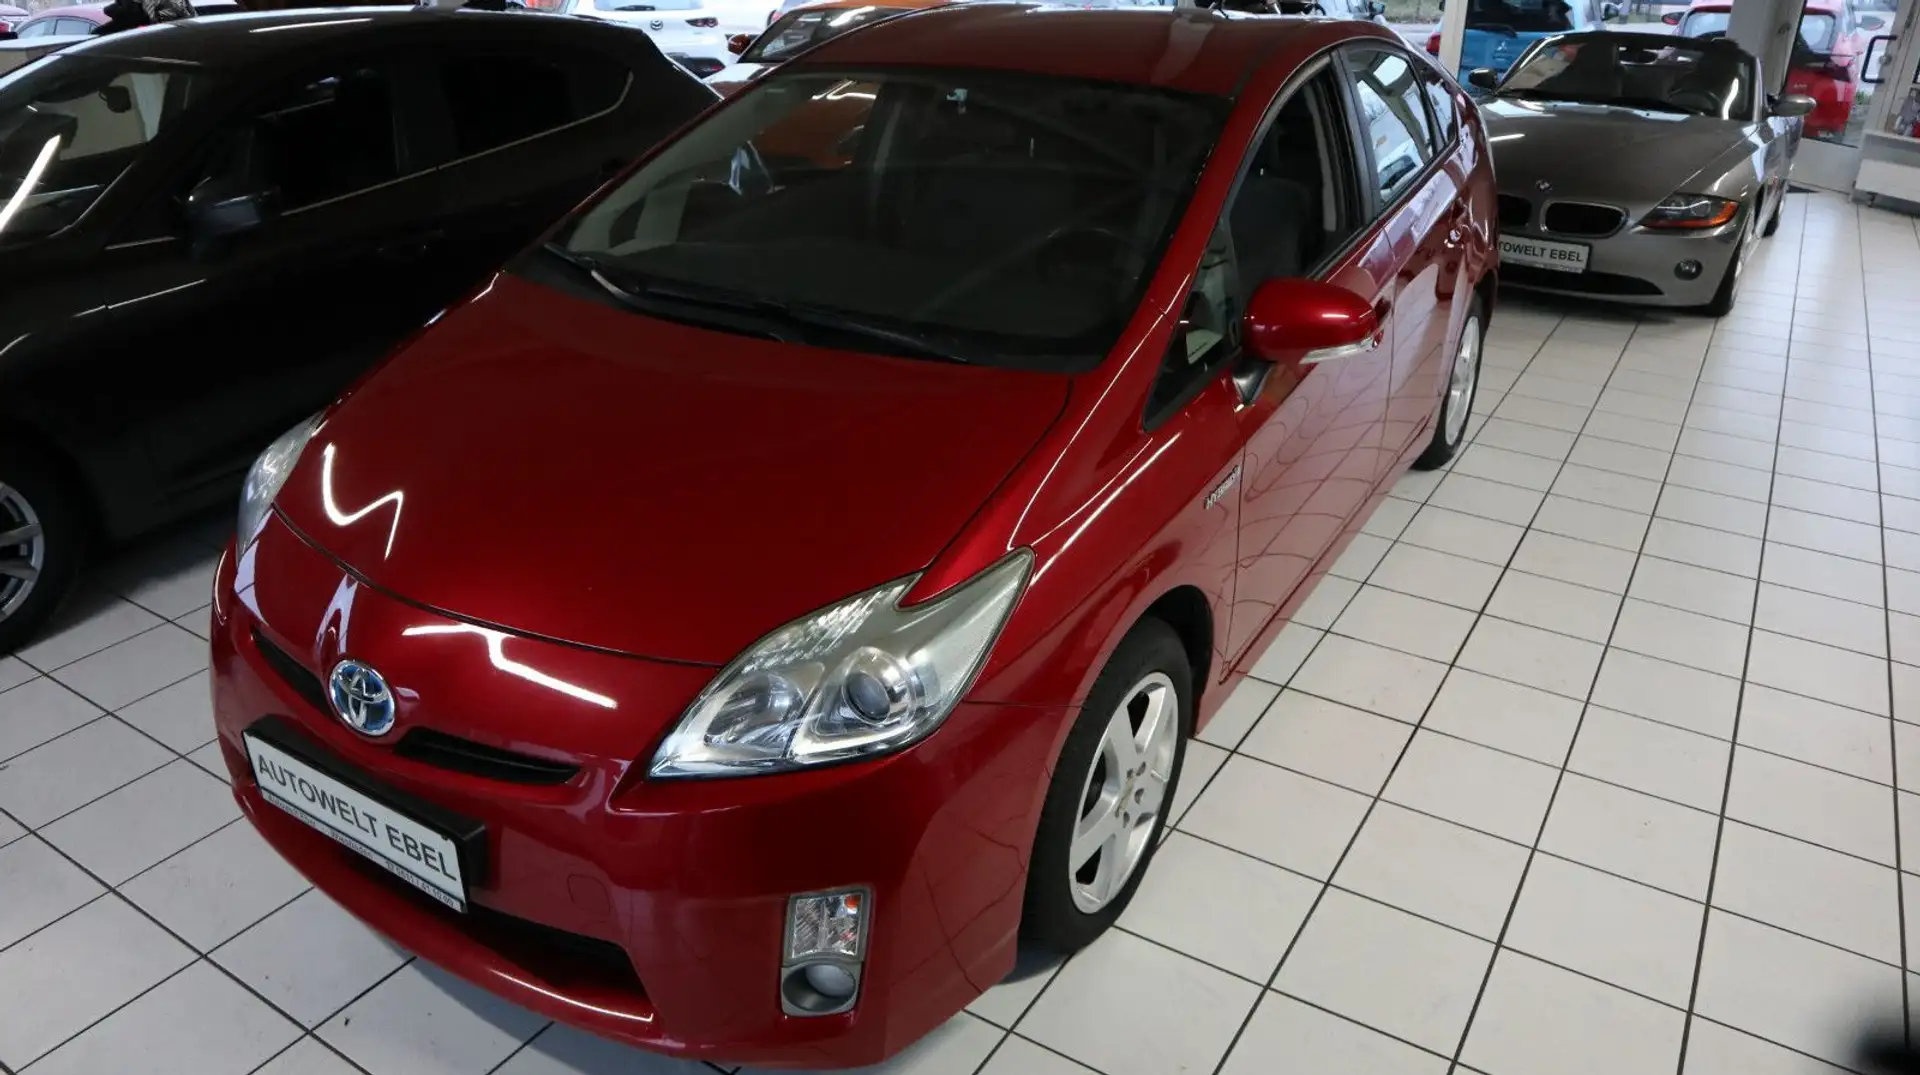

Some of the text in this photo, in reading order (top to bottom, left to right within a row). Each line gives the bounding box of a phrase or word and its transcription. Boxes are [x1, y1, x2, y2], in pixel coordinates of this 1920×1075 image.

[1549, 249, 1584, 262] EBEL
[258, 754, 378, 838] AUTOWELT
[385, 823, 457, 882] EBEL
